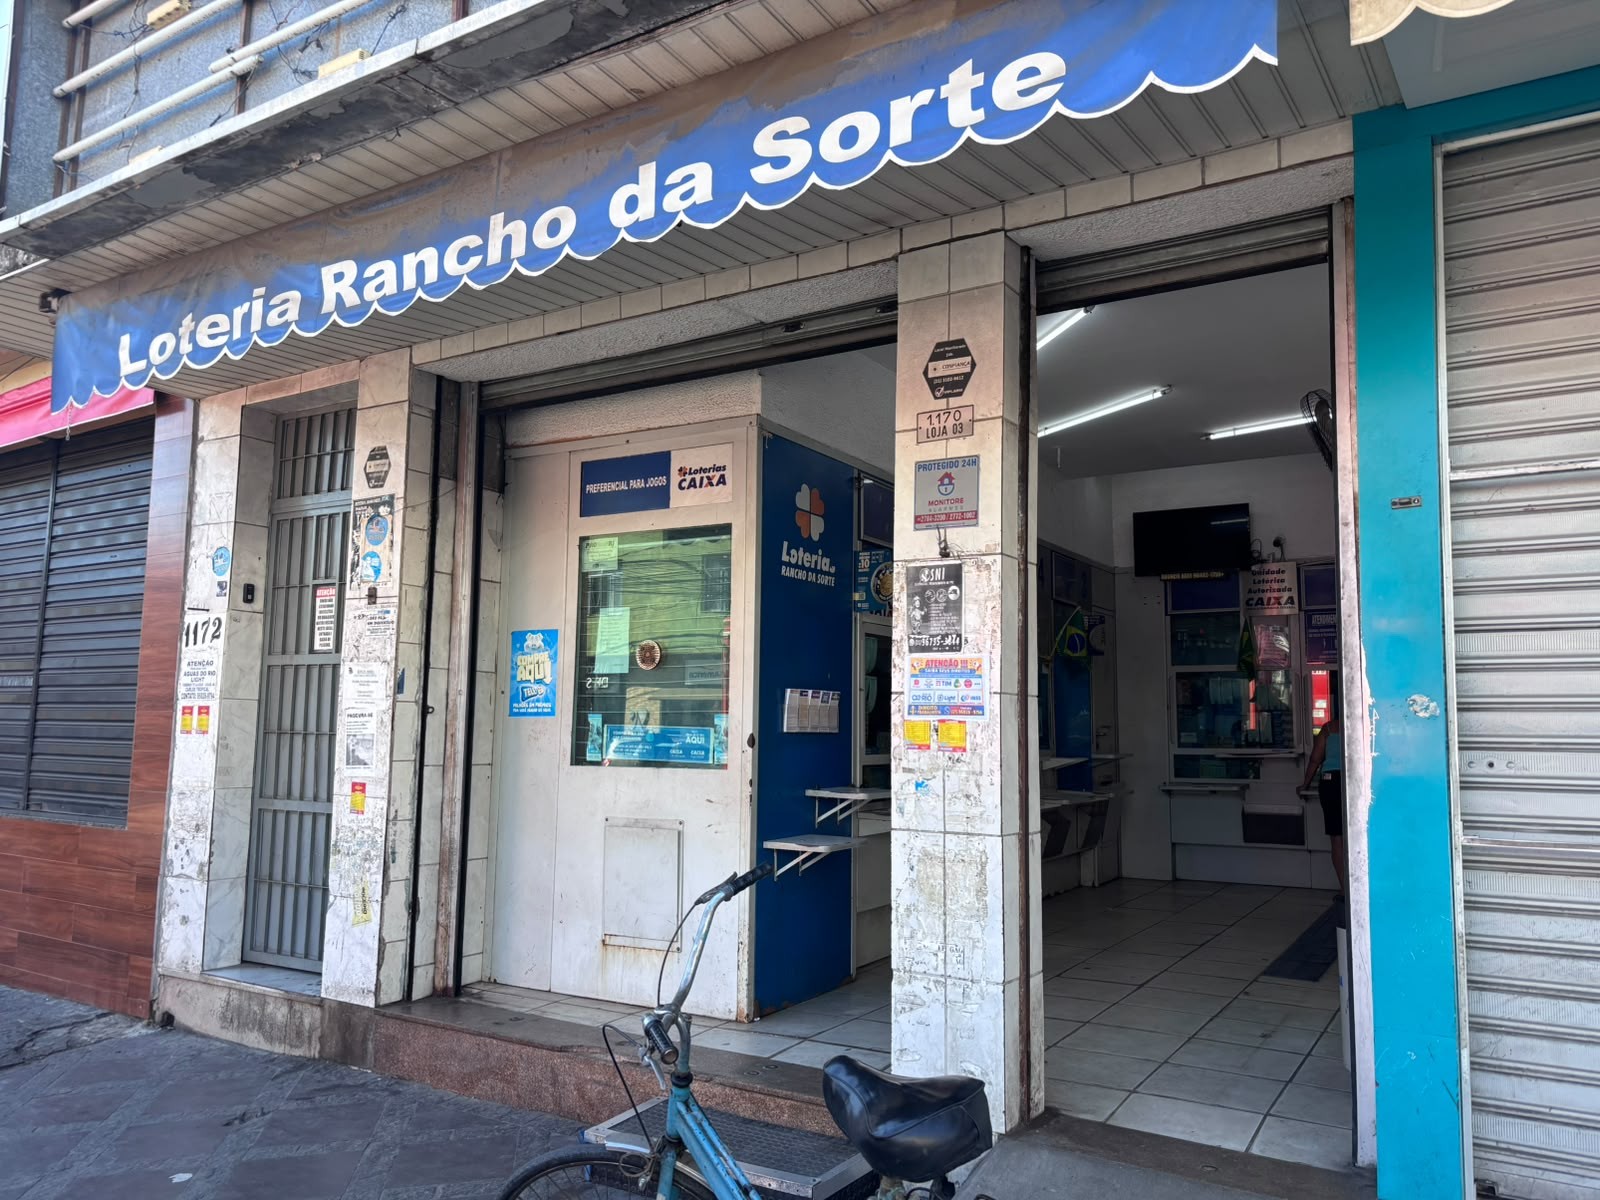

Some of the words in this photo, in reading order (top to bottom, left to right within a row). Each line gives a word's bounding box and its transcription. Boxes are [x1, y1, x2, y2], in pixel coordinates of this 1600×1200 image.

[119, 286, 302, 377] Loteria
[320, 205, 577, 314] Rancho
[608, 161, 713, 230] da
[750, 51, 1066, 185] Sorte
[926, 425, 948, 439] LOJA
[952, 422, 964, 435] 03
[688, 463, 727, 476] Loterias
[917, 460, 959, 472] PROTEGIDO
[961, 458, 977, 467] 24H
[586, 480, 629, 494] PREFERENCIAL
[629, 478, 645, 490] PARA
[646, 475, 667, 488] JOGOS
[677, 473, 727, 491] CAIXA
[928, 497, 964, 507] MONITORE
[781, 541, 831, 572] Loteria
[781, 565, 806, 581] RANCHO
[808, 571, 816, 582] DA
[816, 573, 835, 587] SORTE
[1251, 567, 1286, 576] Unidade
[1247, 586, 1293, 594] Autorizada
[1245, 595, 1295, 607] CAIXA
[184, 616, 223, 647] 1172
[685, 736, 705, 744] AQUI
